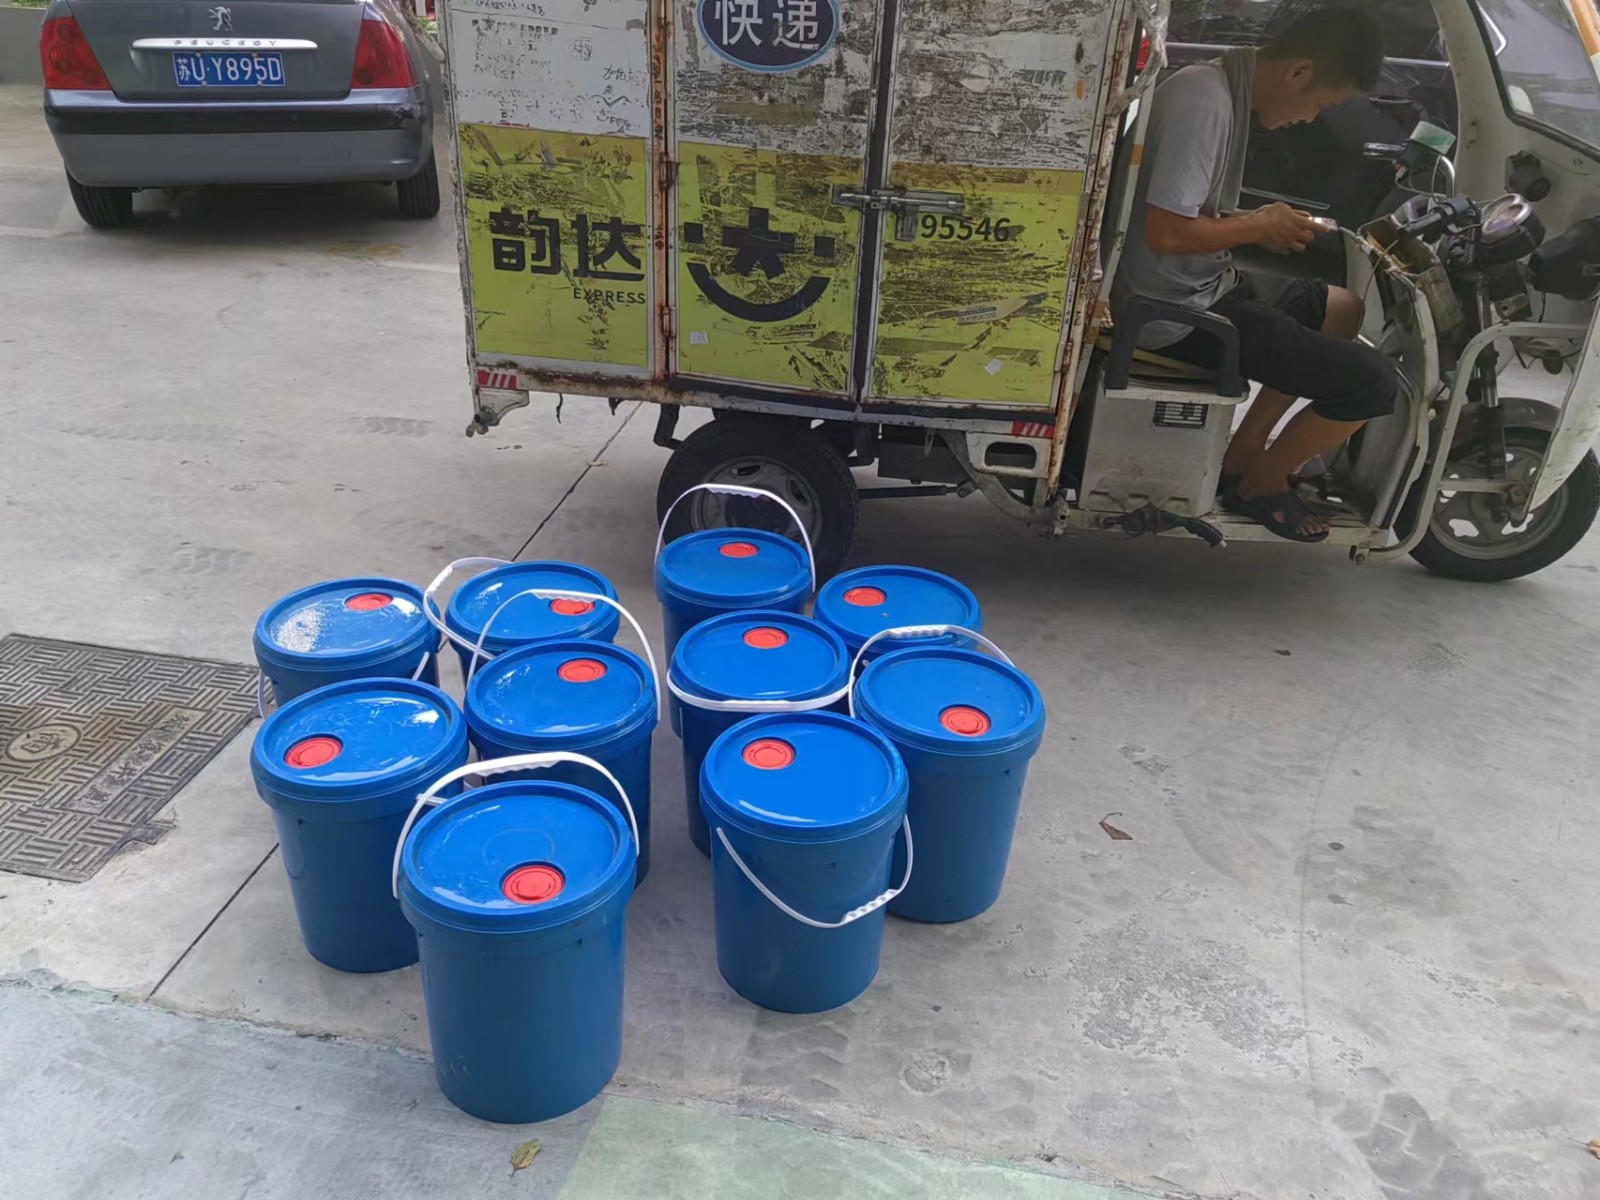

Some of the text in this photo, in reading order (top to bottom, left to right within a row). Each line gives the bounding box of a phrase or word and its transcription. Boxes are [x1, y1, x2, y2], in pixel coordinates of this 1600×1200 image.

[714, 0, 820, 50] 快递
[489, 207, 645, 282] 韵达
[920, 214, 1012, 242] 95546
[573, 287, 646, 304] EXPRESS
